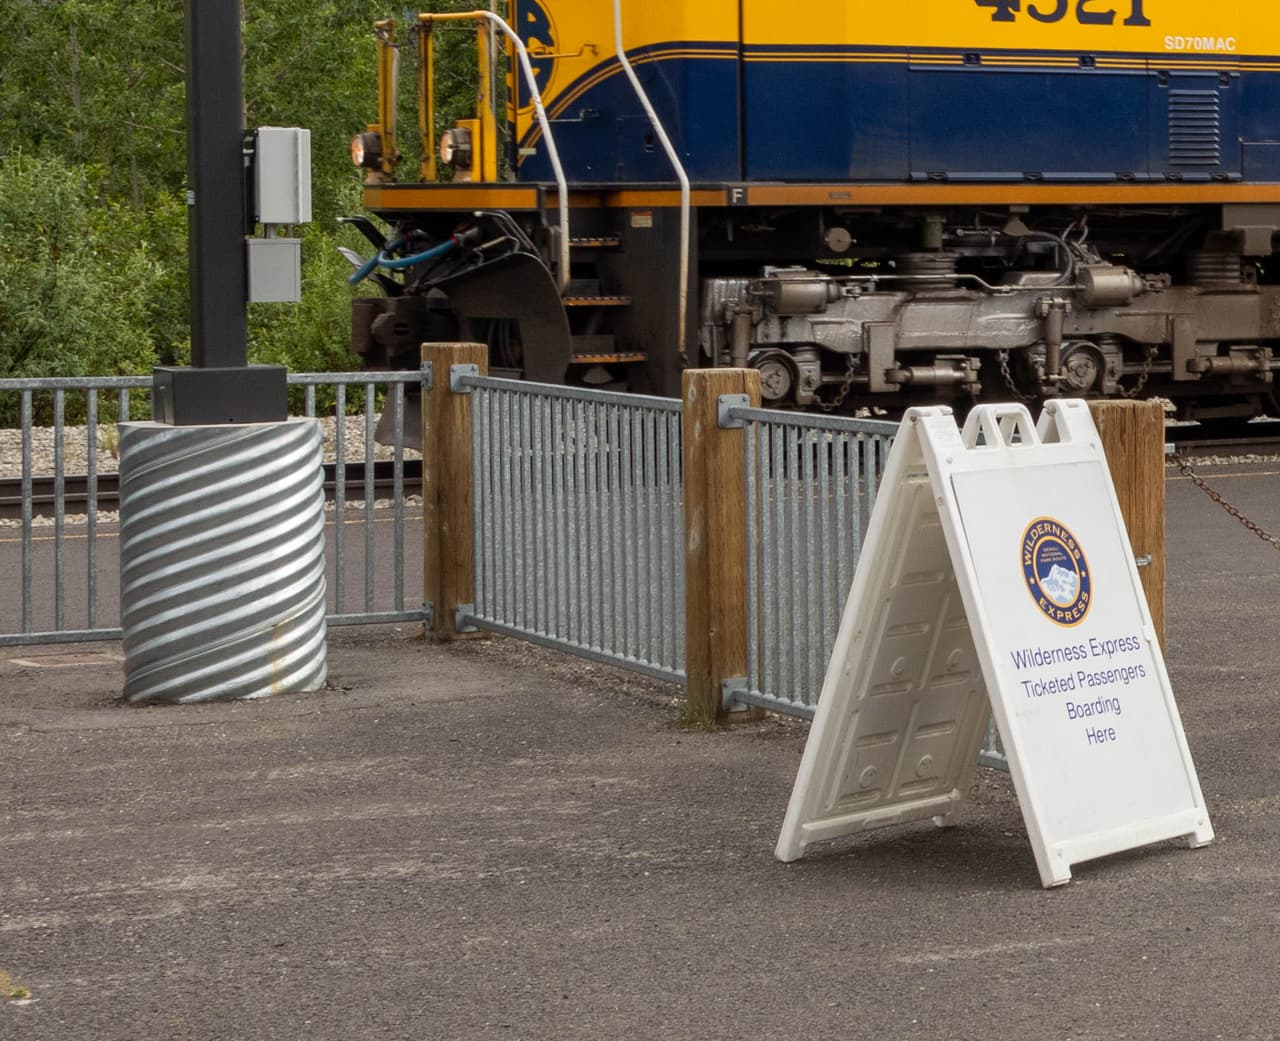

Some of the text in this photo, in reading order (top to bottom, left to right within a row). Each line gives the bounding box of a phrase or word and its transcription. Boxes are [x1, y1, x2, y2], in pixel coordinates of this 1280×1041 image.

[1164, 35, 1236, 51] SD70MAC
[732, 188, 744, 204] F
[1024, 523, 1081, 566] WILDERNESS
[1039, 591, 1088, 621] EXPRESS
[1011, 636, 1140, 669] Wilderness Express
[1021, 664, 1146, 698] Ticketed Passengers
[1066, 696, 1121, 719] Boarding
[1086, 726, 1116, 744] Here
